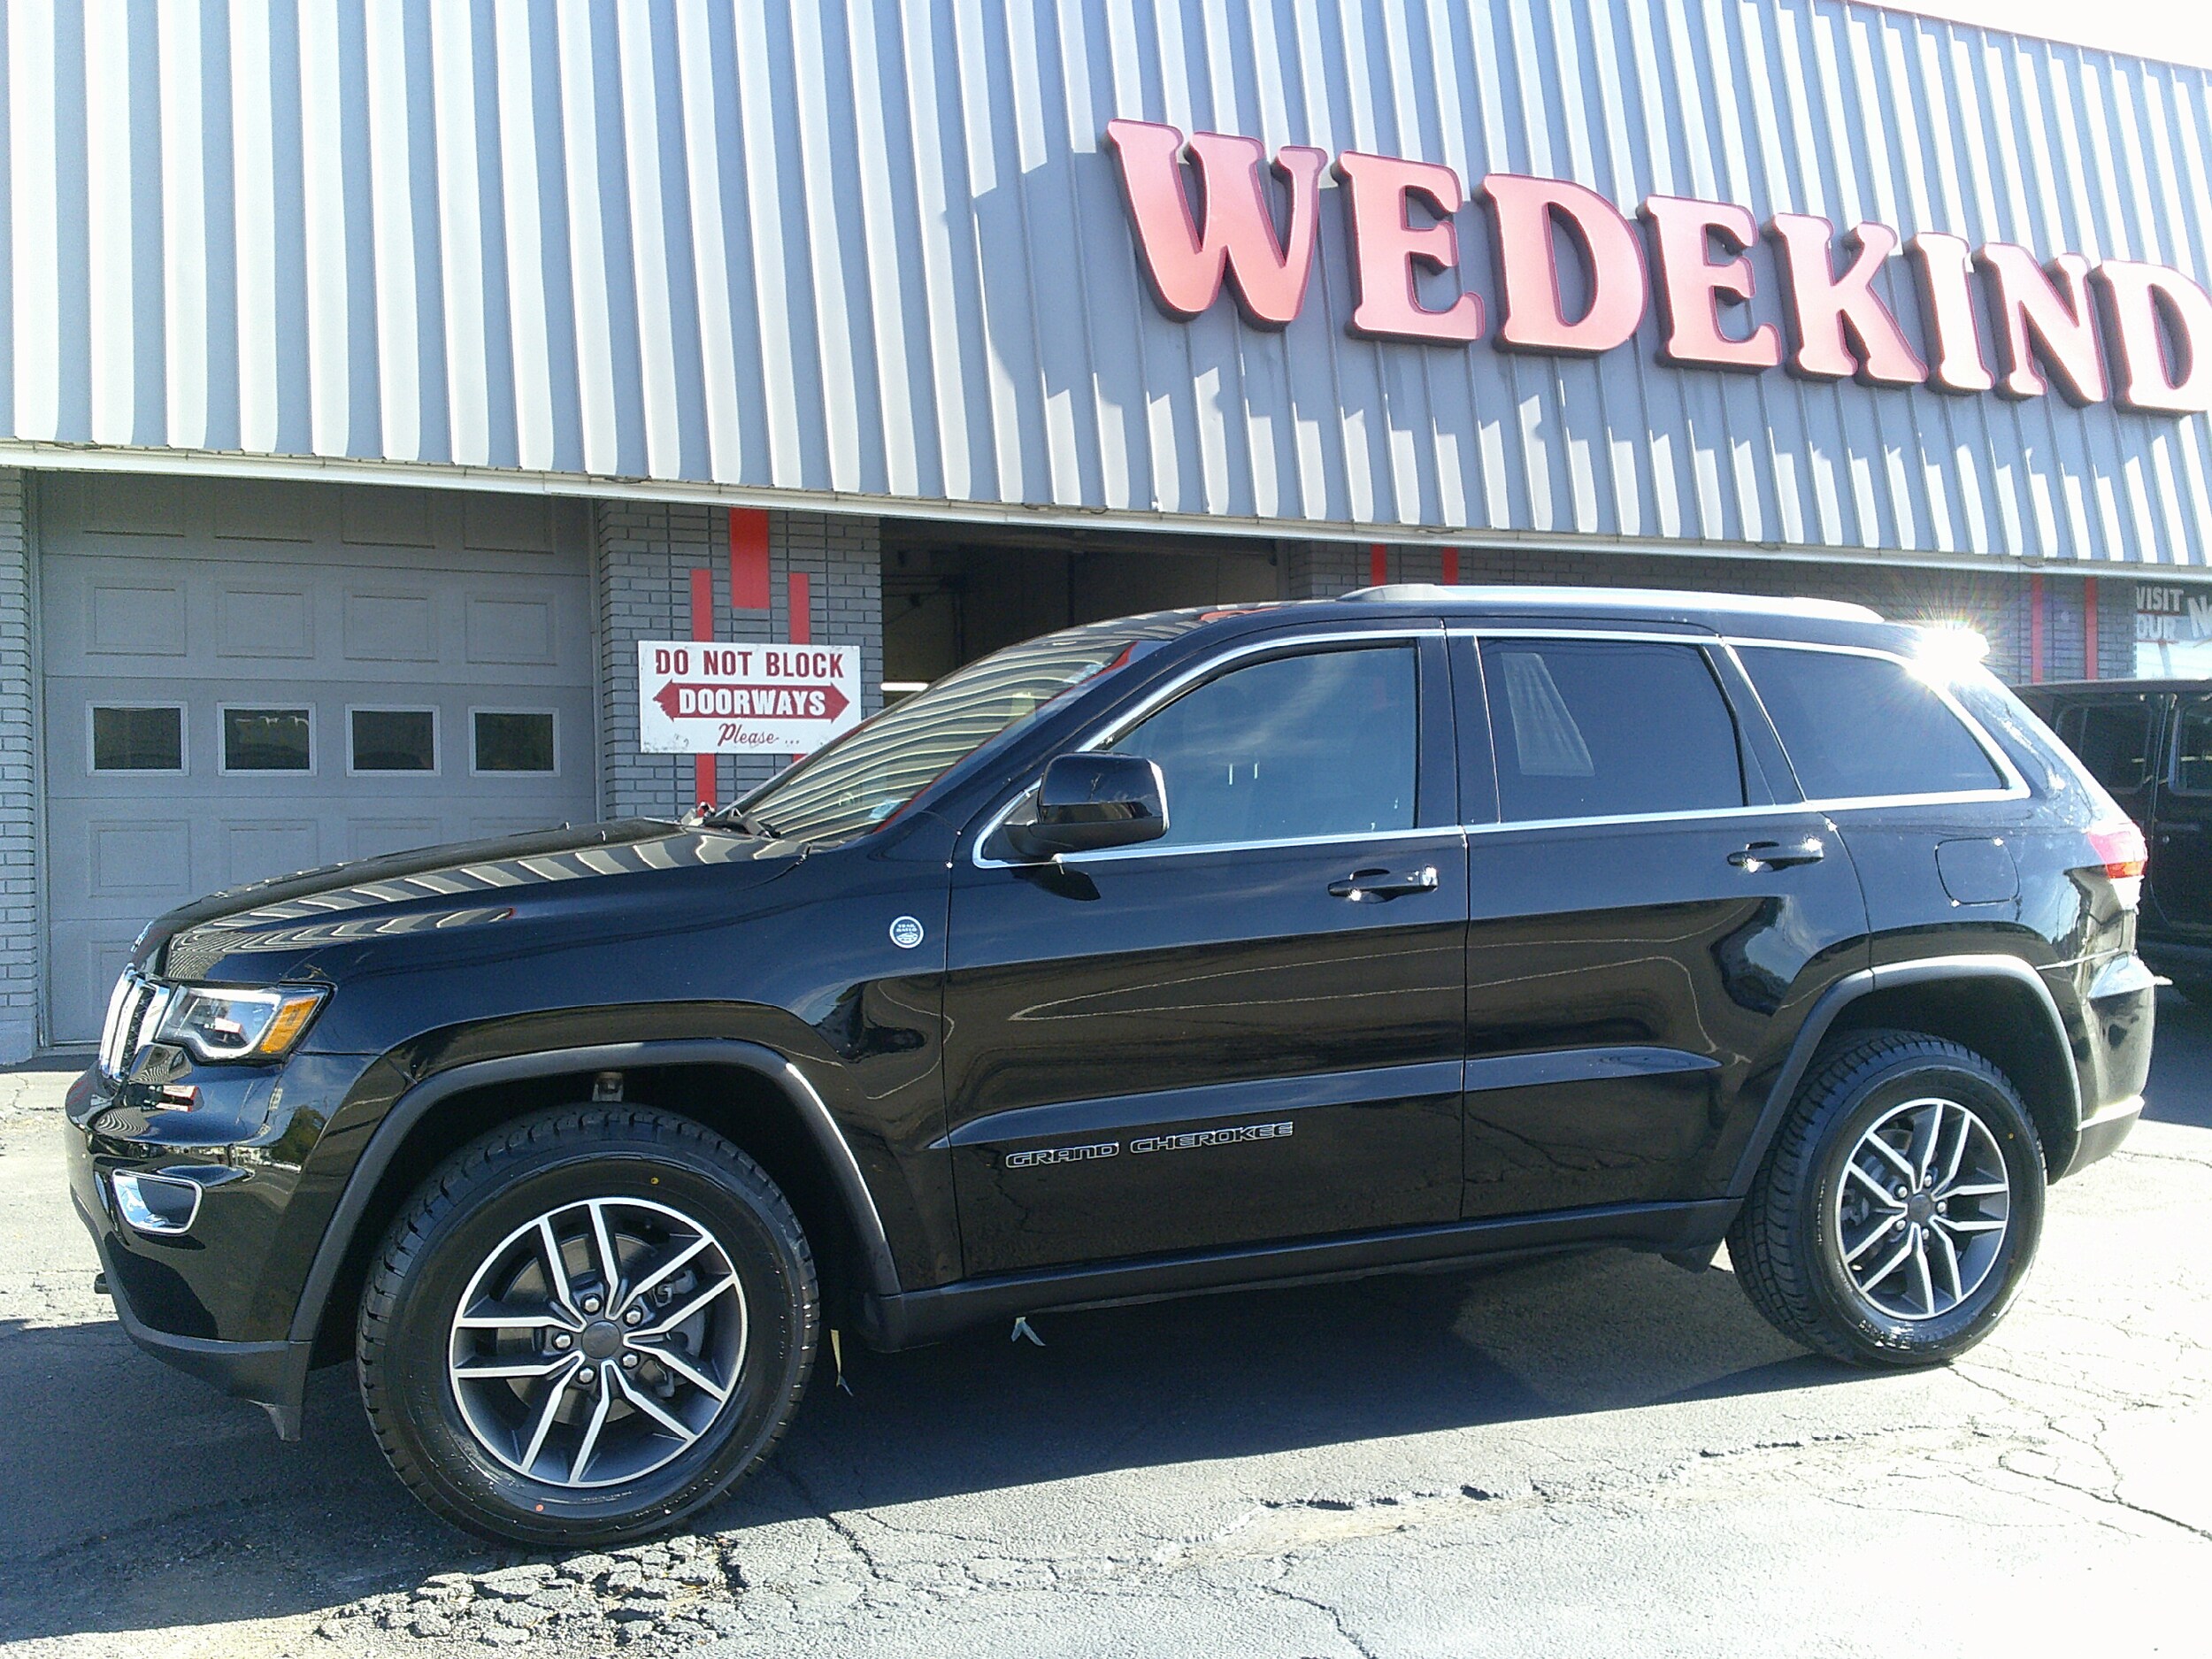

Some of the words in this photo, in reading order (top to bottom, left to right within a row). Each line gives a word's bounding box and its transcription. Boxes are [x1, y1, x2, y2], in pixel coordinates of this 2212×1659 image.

[1104, 118, 2212, 418] WEDEKIND
[2135, 586, 2184, 612] VISIT
[2187, 595, 2212, 638] N
[655, 649, 689, 675] DO
[703, 650, 752, 676] NOT
[765, 652, 844, 679] BLOCK
[679, 688, 826, 716] DOORWAYS
[1005, 1141, 1119, 1169] GRAND
[1130, 1121, 1294, 1154] CHEROKEE
